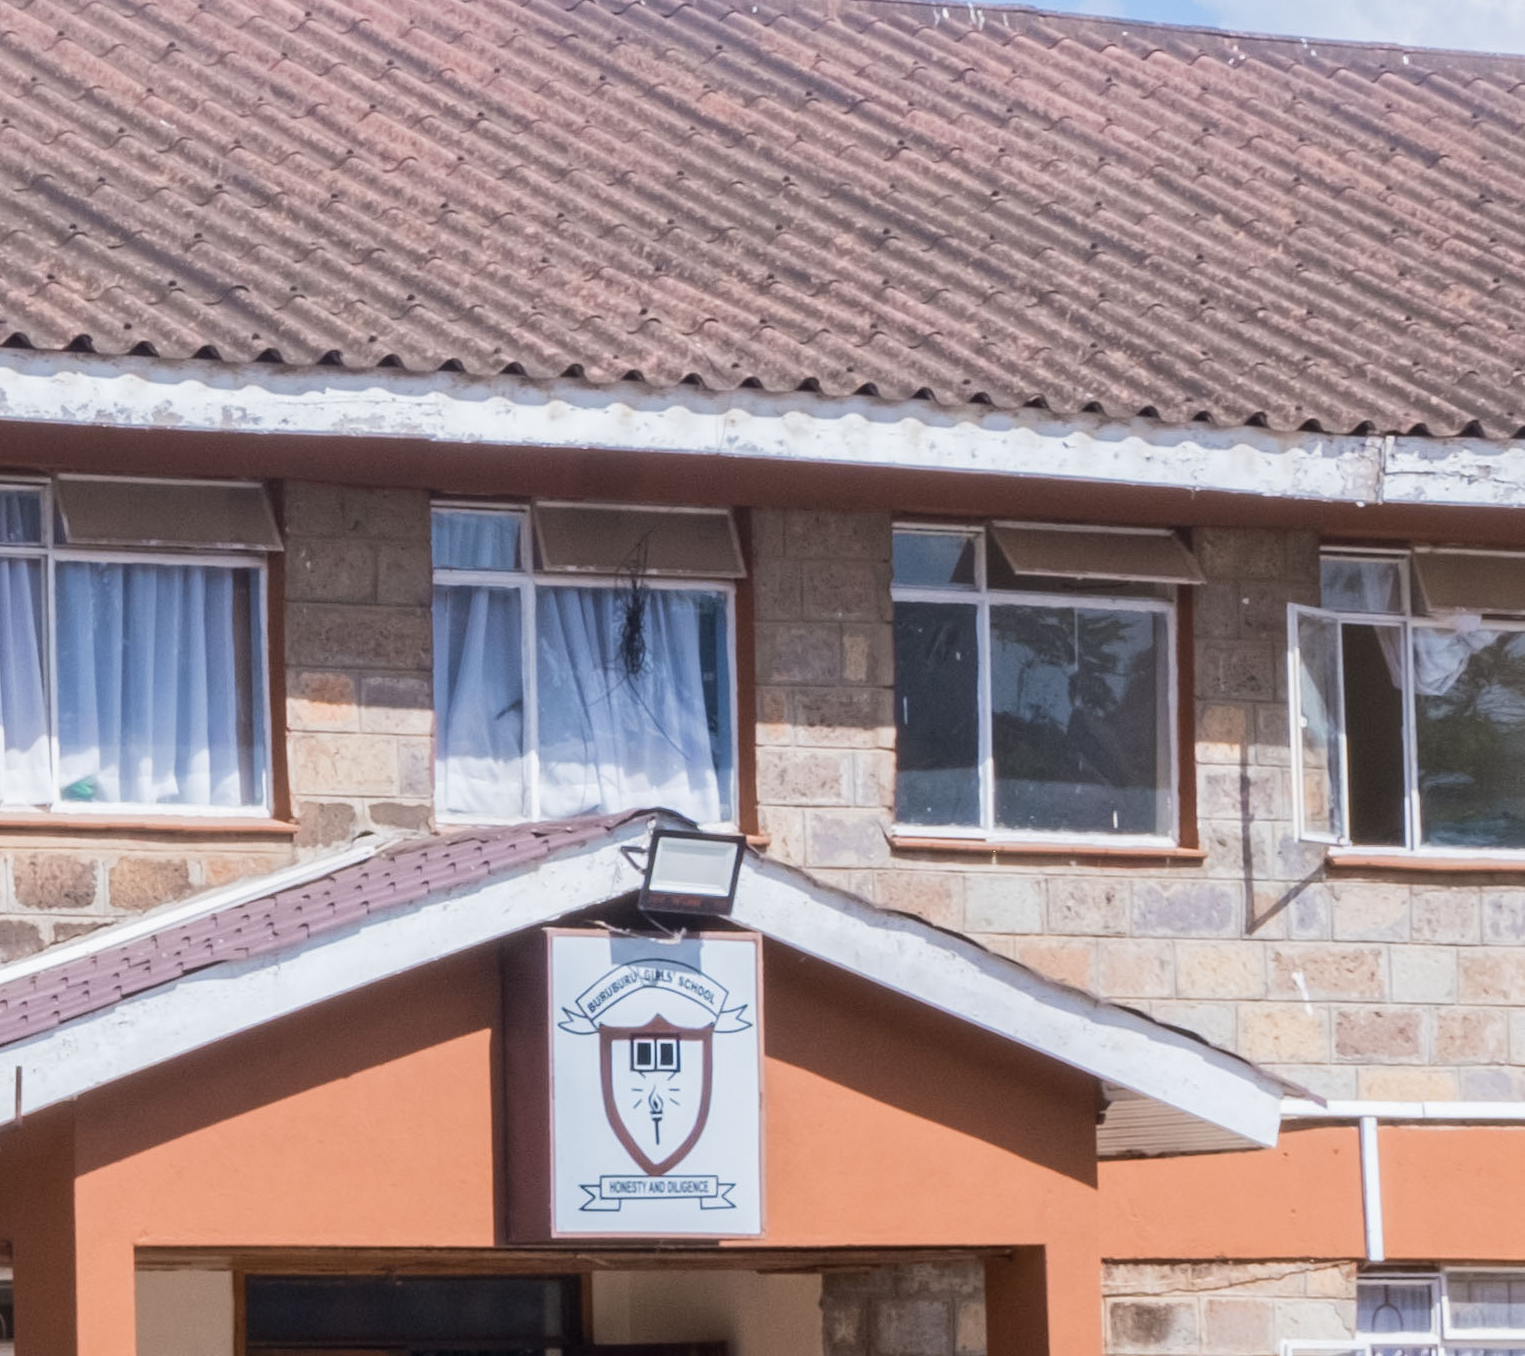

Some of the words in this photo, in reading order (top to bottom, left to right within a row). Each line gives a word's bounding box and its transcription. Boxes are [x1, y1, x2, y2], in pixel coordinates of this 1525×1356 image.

[587, 972, 639, 1013] BURUBURU
[678, 975, 715, 1005] SCHOOL
[609, 1180, 646, 1193] HONESTY
[649, 1180, 665, 1193] AND
[668, 1180, 708, 1192] DILIGENCE
